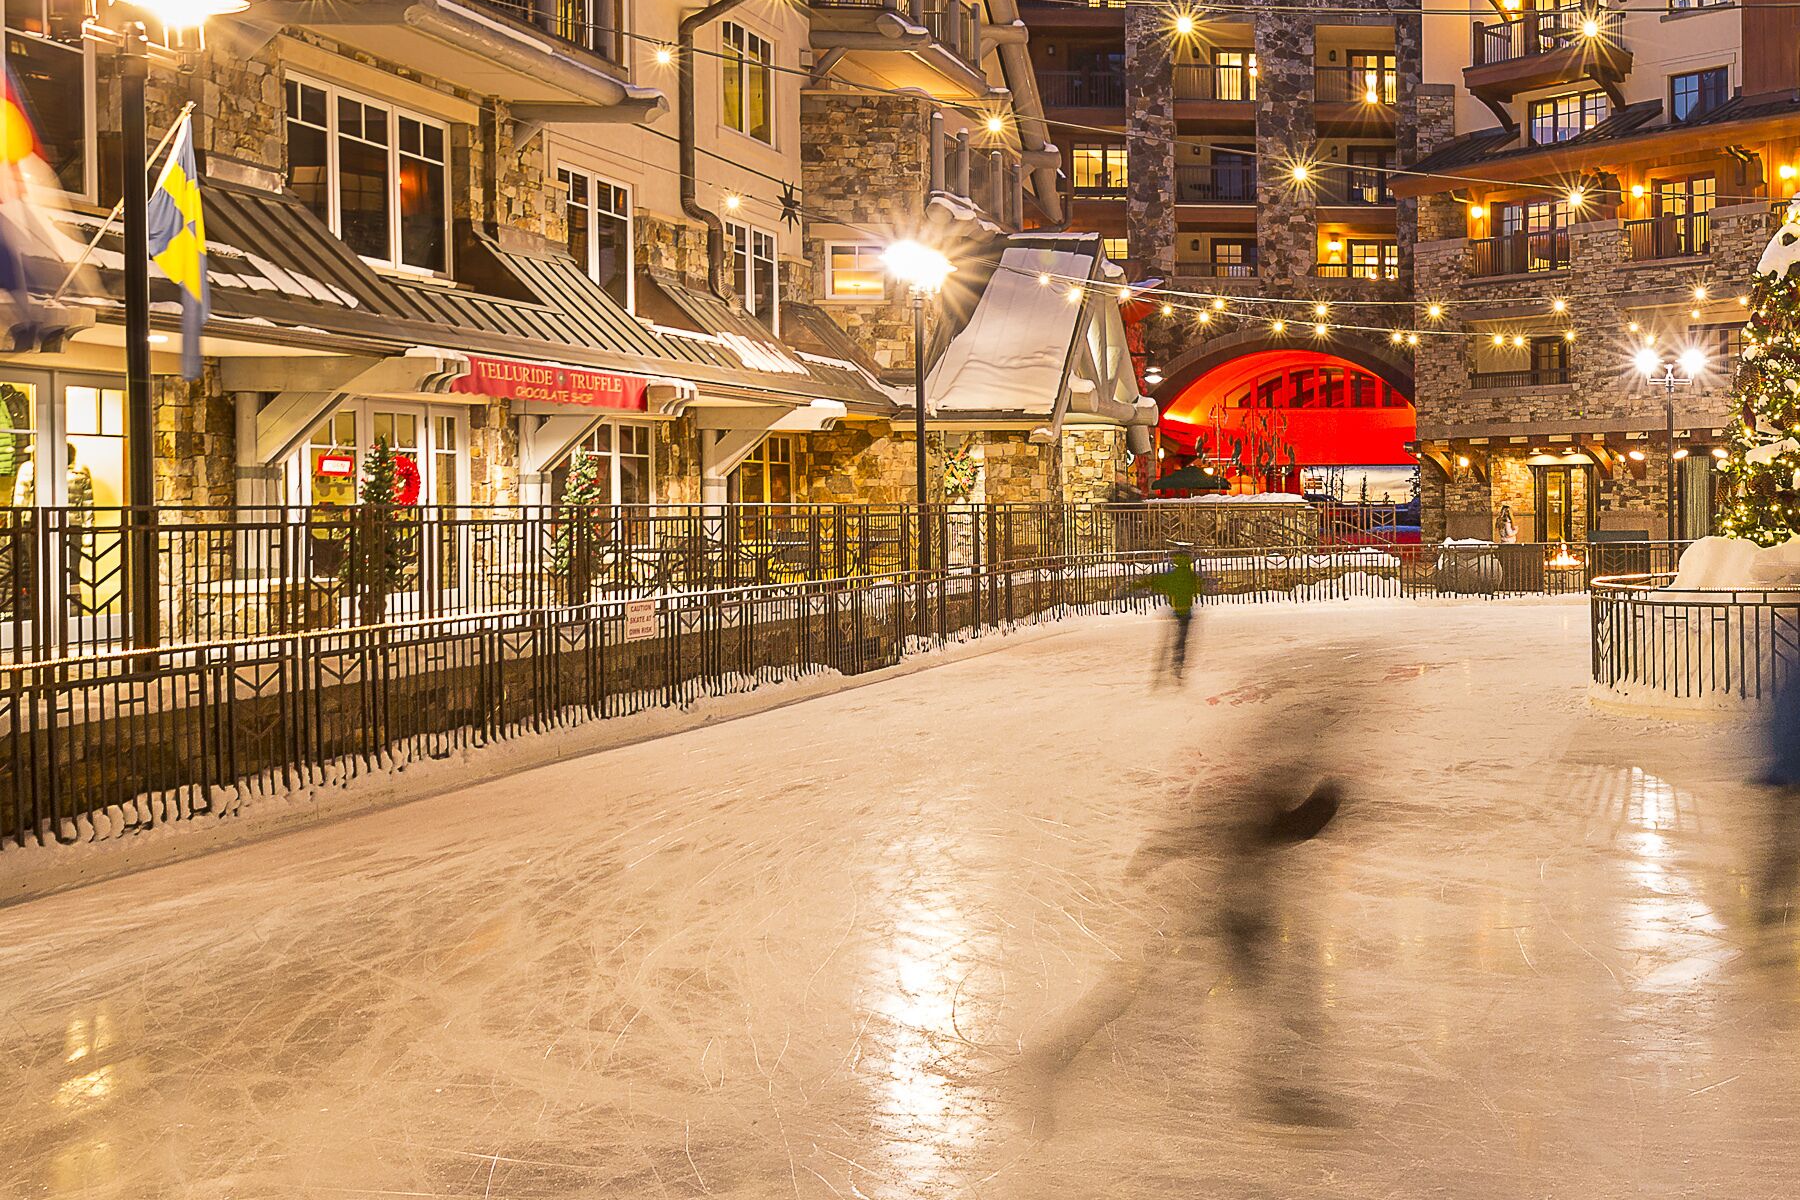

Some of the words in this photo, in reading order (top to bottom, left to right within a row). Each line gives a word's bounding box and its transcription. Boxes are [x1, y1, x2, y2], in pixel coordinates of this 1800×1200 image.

[478, 361, 553, 386] TELLURIDE
[570, 373, 622, 392] TRUFFLE
[516, 386, 569, 402] CHOCOLATE
[571, 392, 593, 403] SHOP
[630, 616, 645, 624] SKATE
